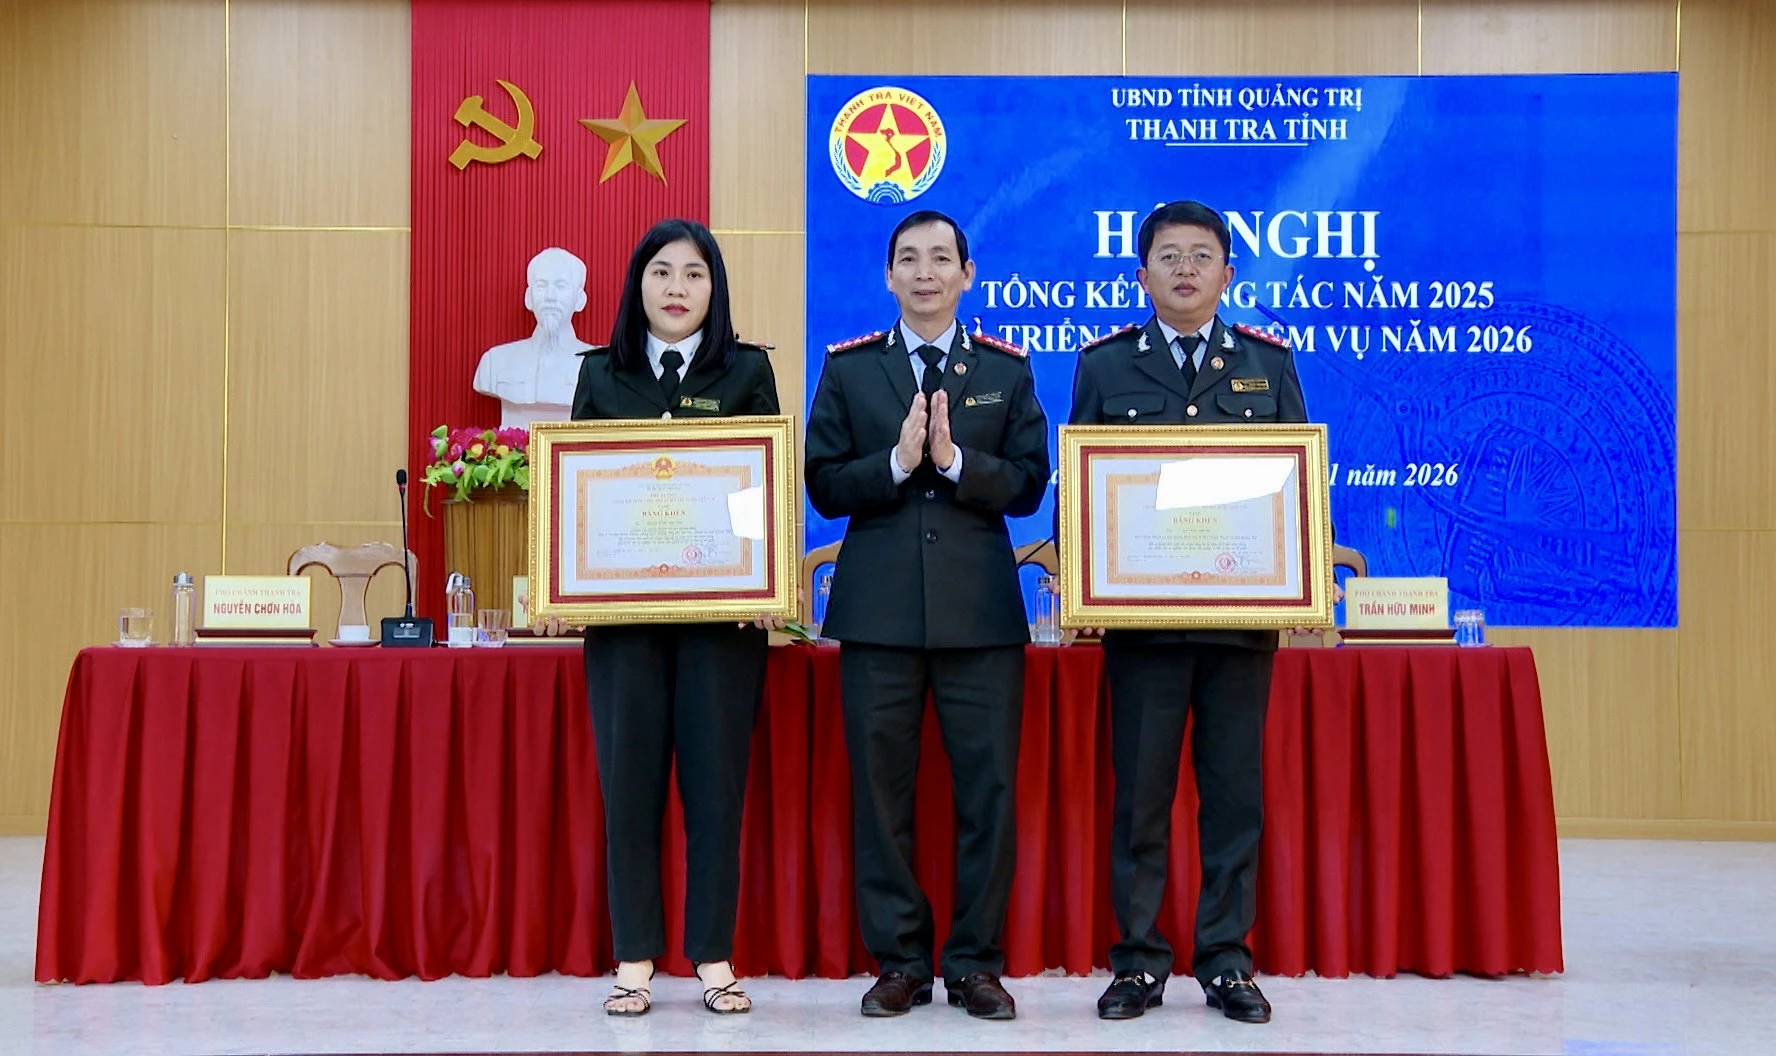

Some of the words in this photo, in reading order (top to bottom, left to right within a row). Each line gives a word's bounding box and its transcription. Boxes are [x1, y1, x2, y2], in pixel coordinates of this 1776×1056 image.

[1111, 88, 1173, 107] UBND
[1178, 83, 1232, 107] TỈNH
[1238, 83, 1319, 111] QUẢNG
[1324, 88, 1362, 112] TRỊ
[834, 99, 865, 133] THANH
[1125, 118, 1217, 140] THANH
[1224, 118, 1277, 140] TRA
[1283, 112, 1348, 140] TỈNH
[1222, 210, 1381, 273] NGHỊ
[980, 273, 1076, 309] TỔNG
[1085, 273, 1147, 309] KẾT
[1265, 274, 1334, 309] TÁC
[1343, 275, 1420, 309] NĂM
[1428, 281, 1495, 310] 2025
[998, 317, 1100, 352] TRIỂN
[1325, 325, 1371, 360] VỤ
[1381, 319, 1457, 353] NĂM
[1466, 325, 1533, 354] 2026
[1346, 464, 1397, 487] năm
[1403, 463, 1459, 487] 2026
[1409, 603, 1435, 616] MINH
